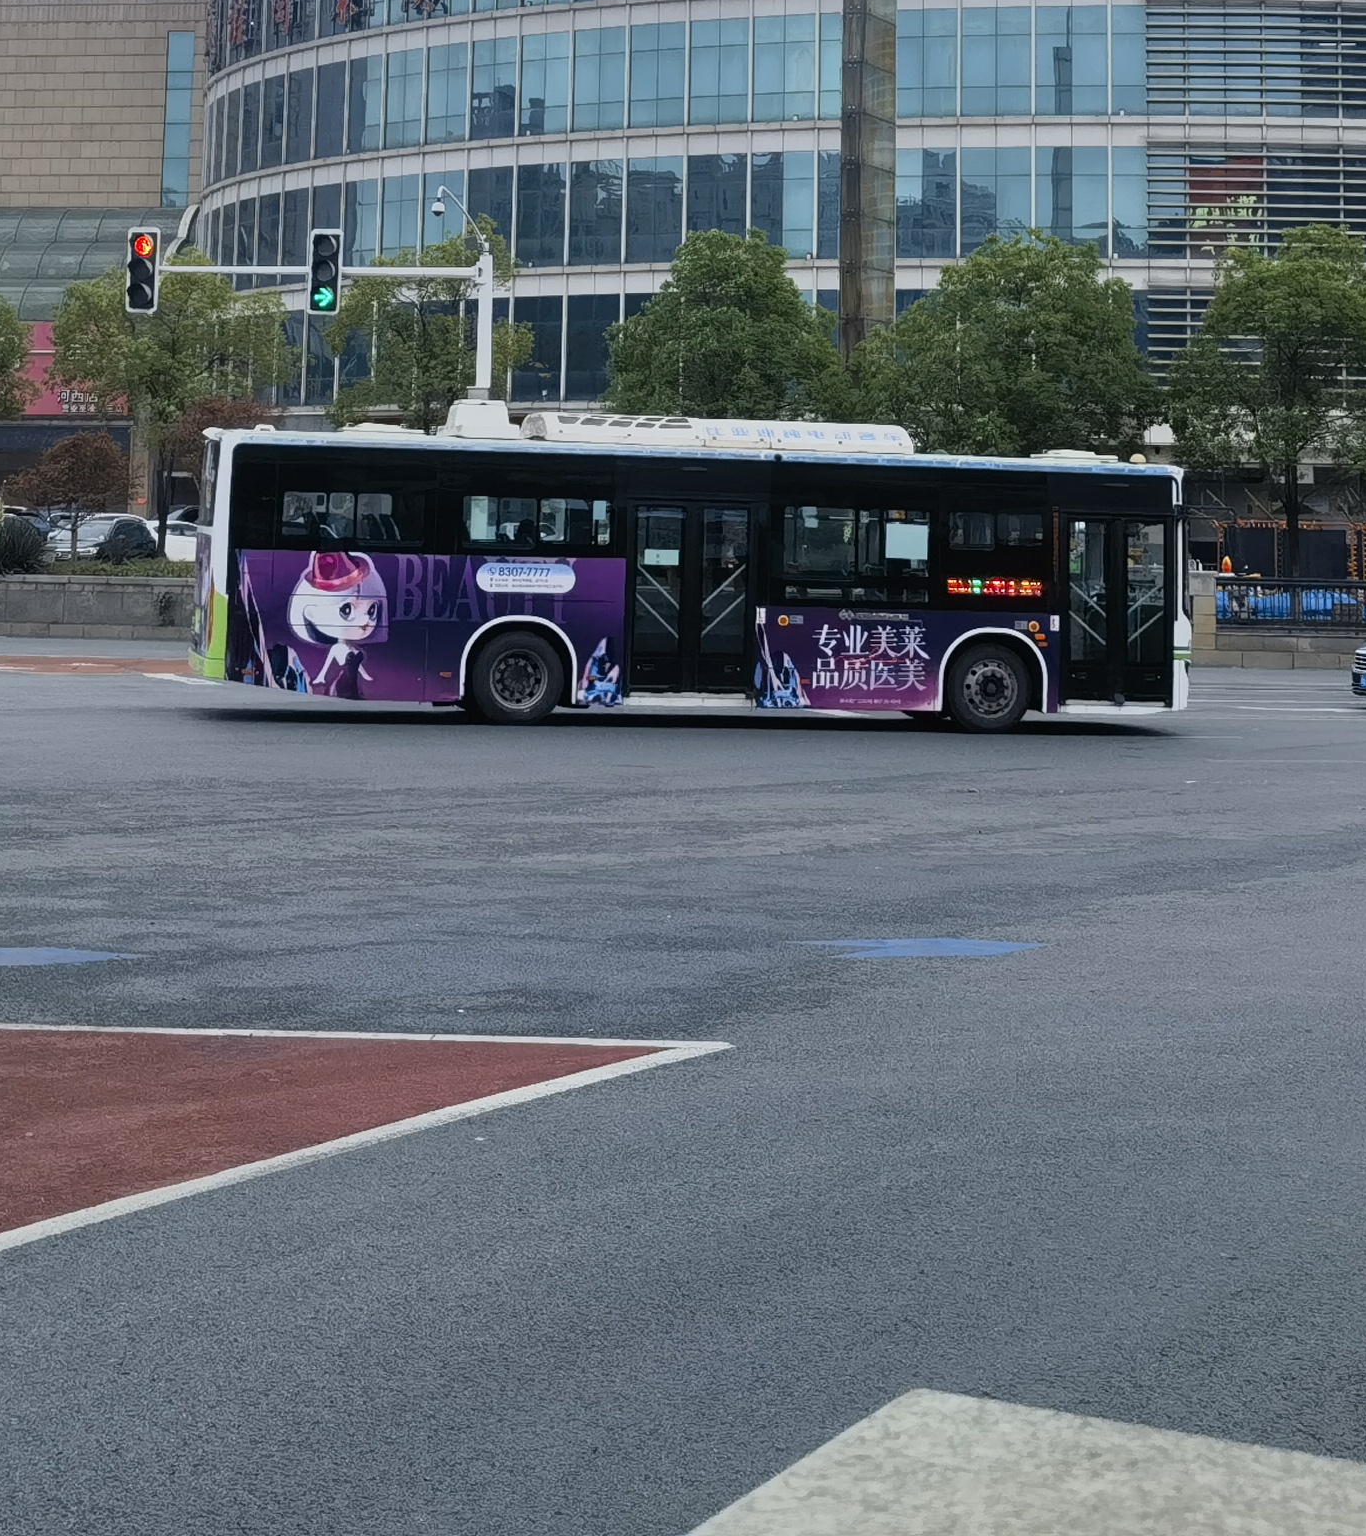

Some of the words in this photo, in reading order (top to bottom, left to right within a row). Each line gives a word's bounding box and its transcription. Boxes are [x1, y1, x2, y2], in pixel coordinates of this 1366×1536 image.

[498, 566, 551, 578] 8307-7777
[812, 623, 931, 660] 专业美莱
[811, 657, 928, 692] 品质医美
